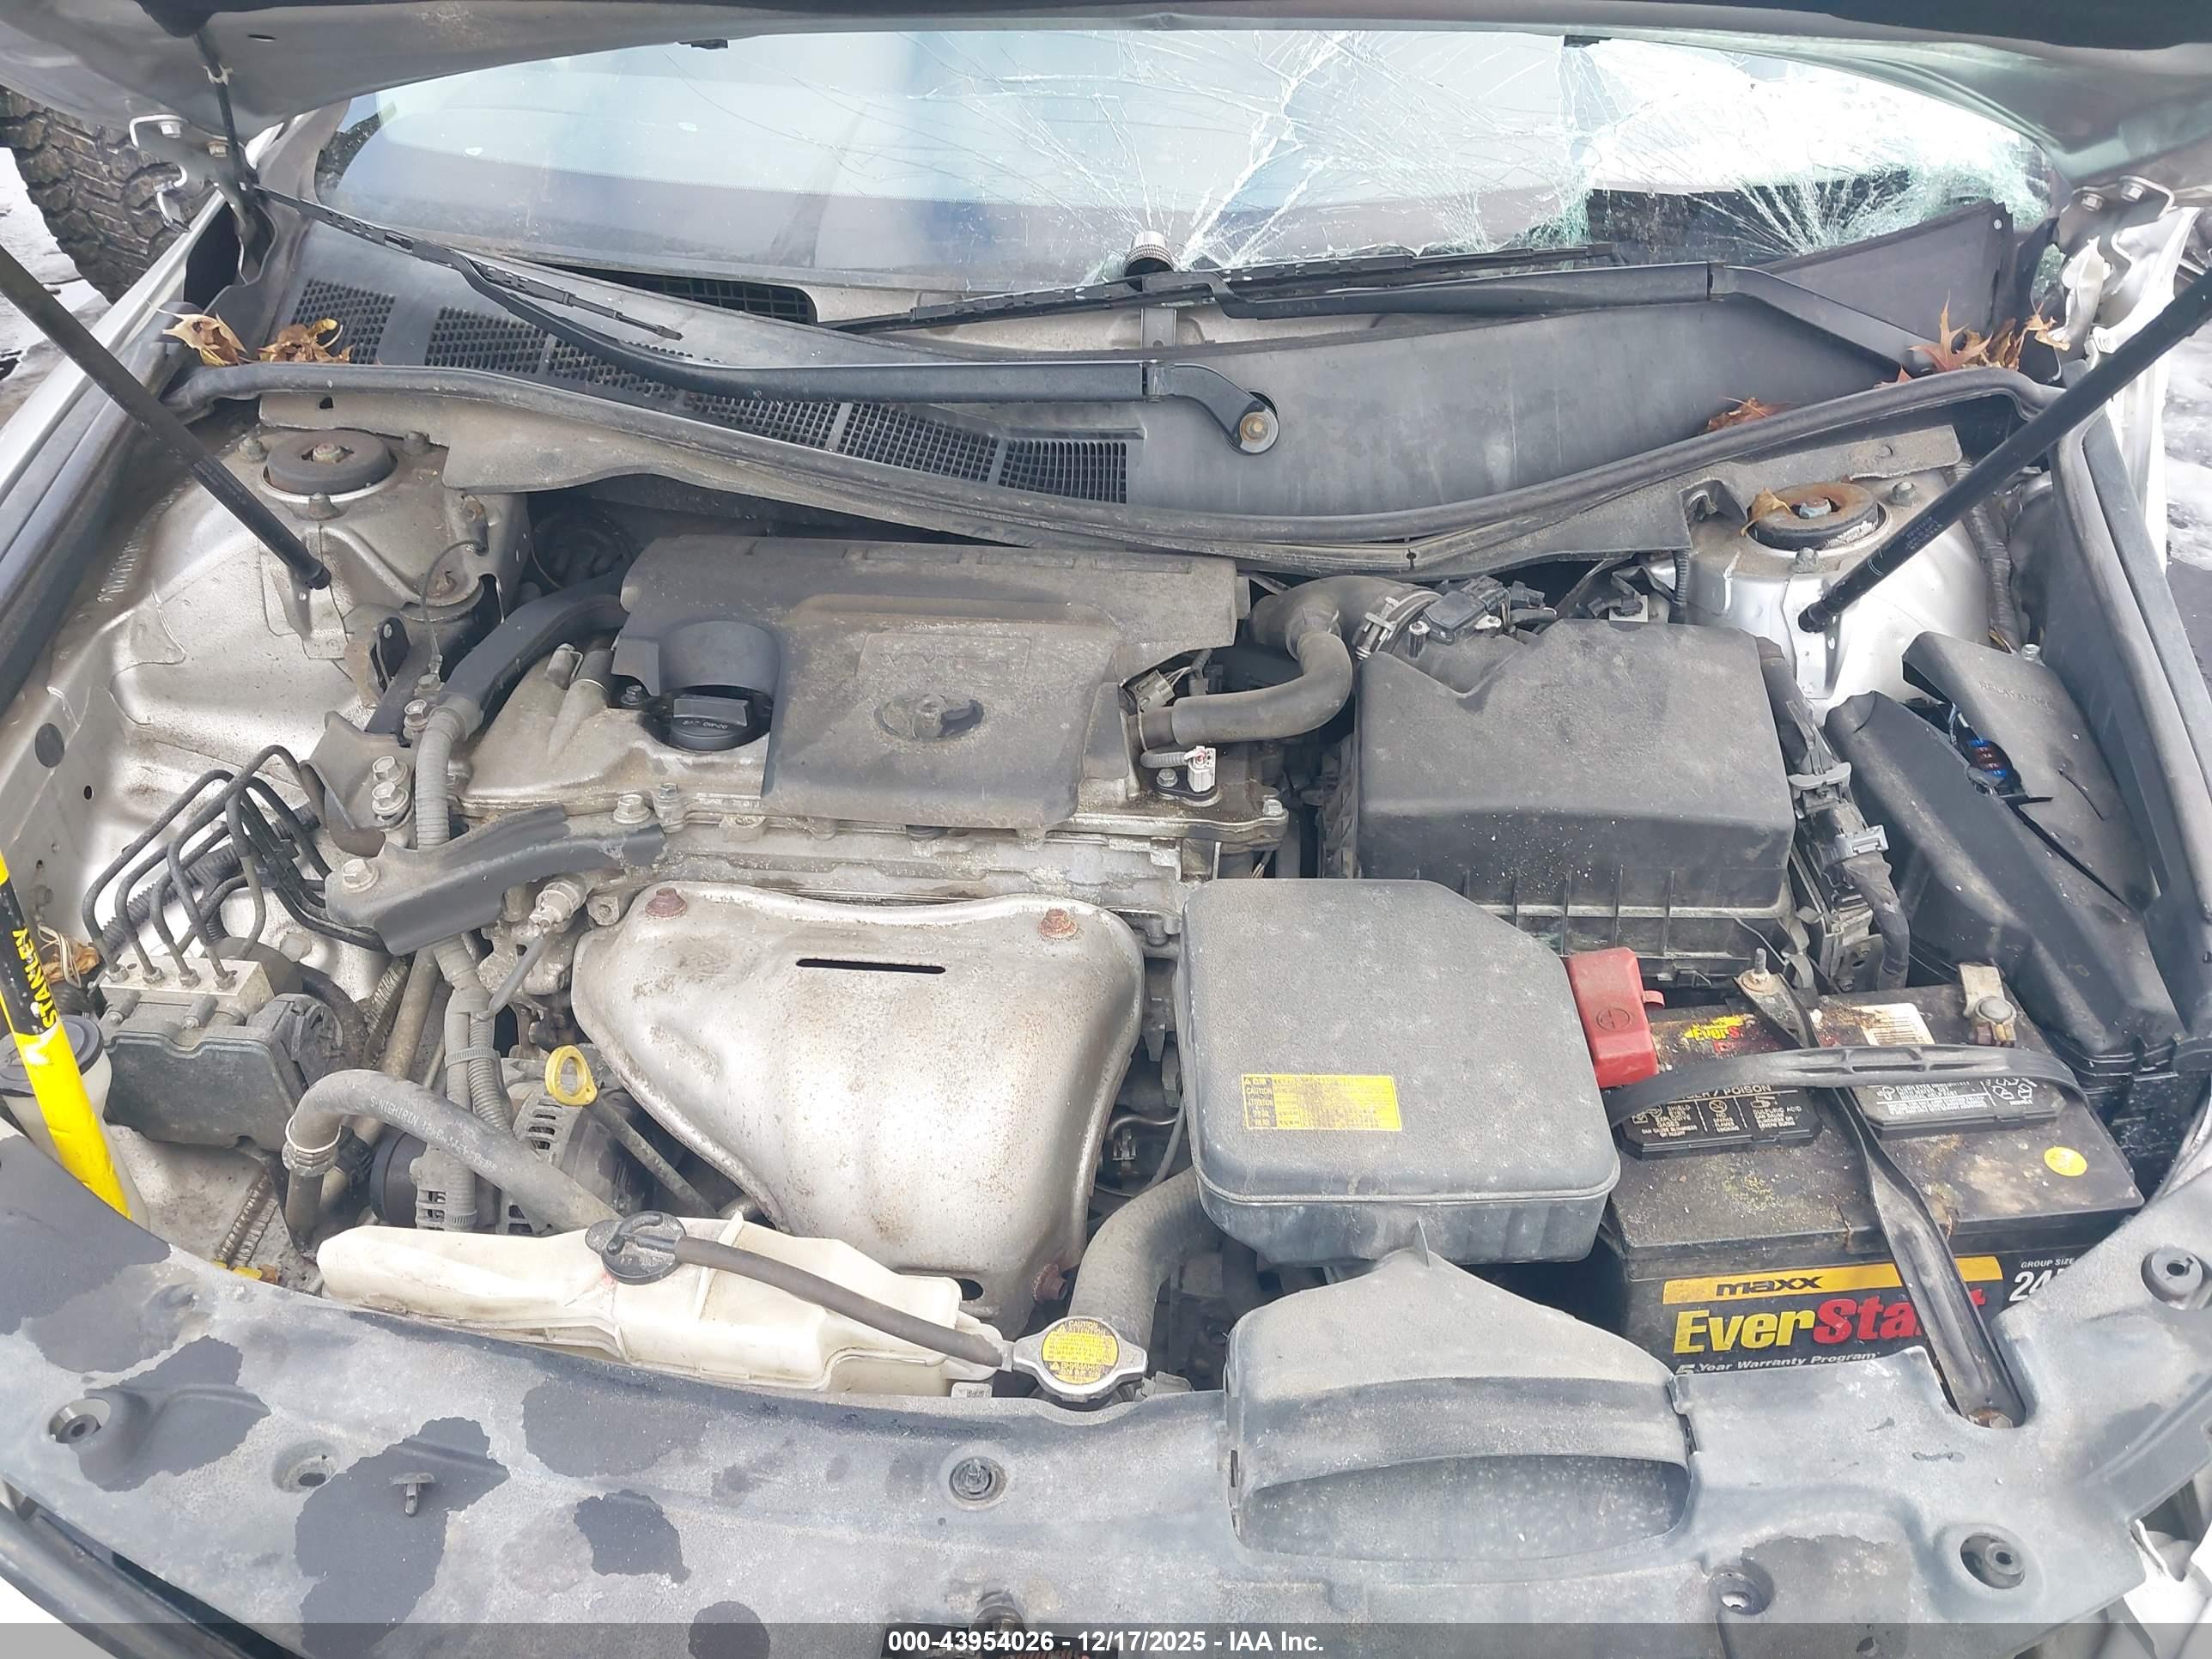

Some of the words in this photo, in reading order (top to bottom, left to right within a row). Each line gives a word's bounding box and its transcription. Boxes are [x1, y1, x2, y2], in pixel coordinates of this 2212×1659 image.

[12, 927, 58, 1028] STANLEY
[1723, 1085, 1772, 1097] POISON
[2020, 1260, 2053, 1269] GROUP
[2054, 1257, 2075, 1267] SIZE
[2009, 1268, 2065, 1302] 24
[1673, 1288, 1986, 1355] EverSta
[1737, 1357, 1805, 1370] Warranty
